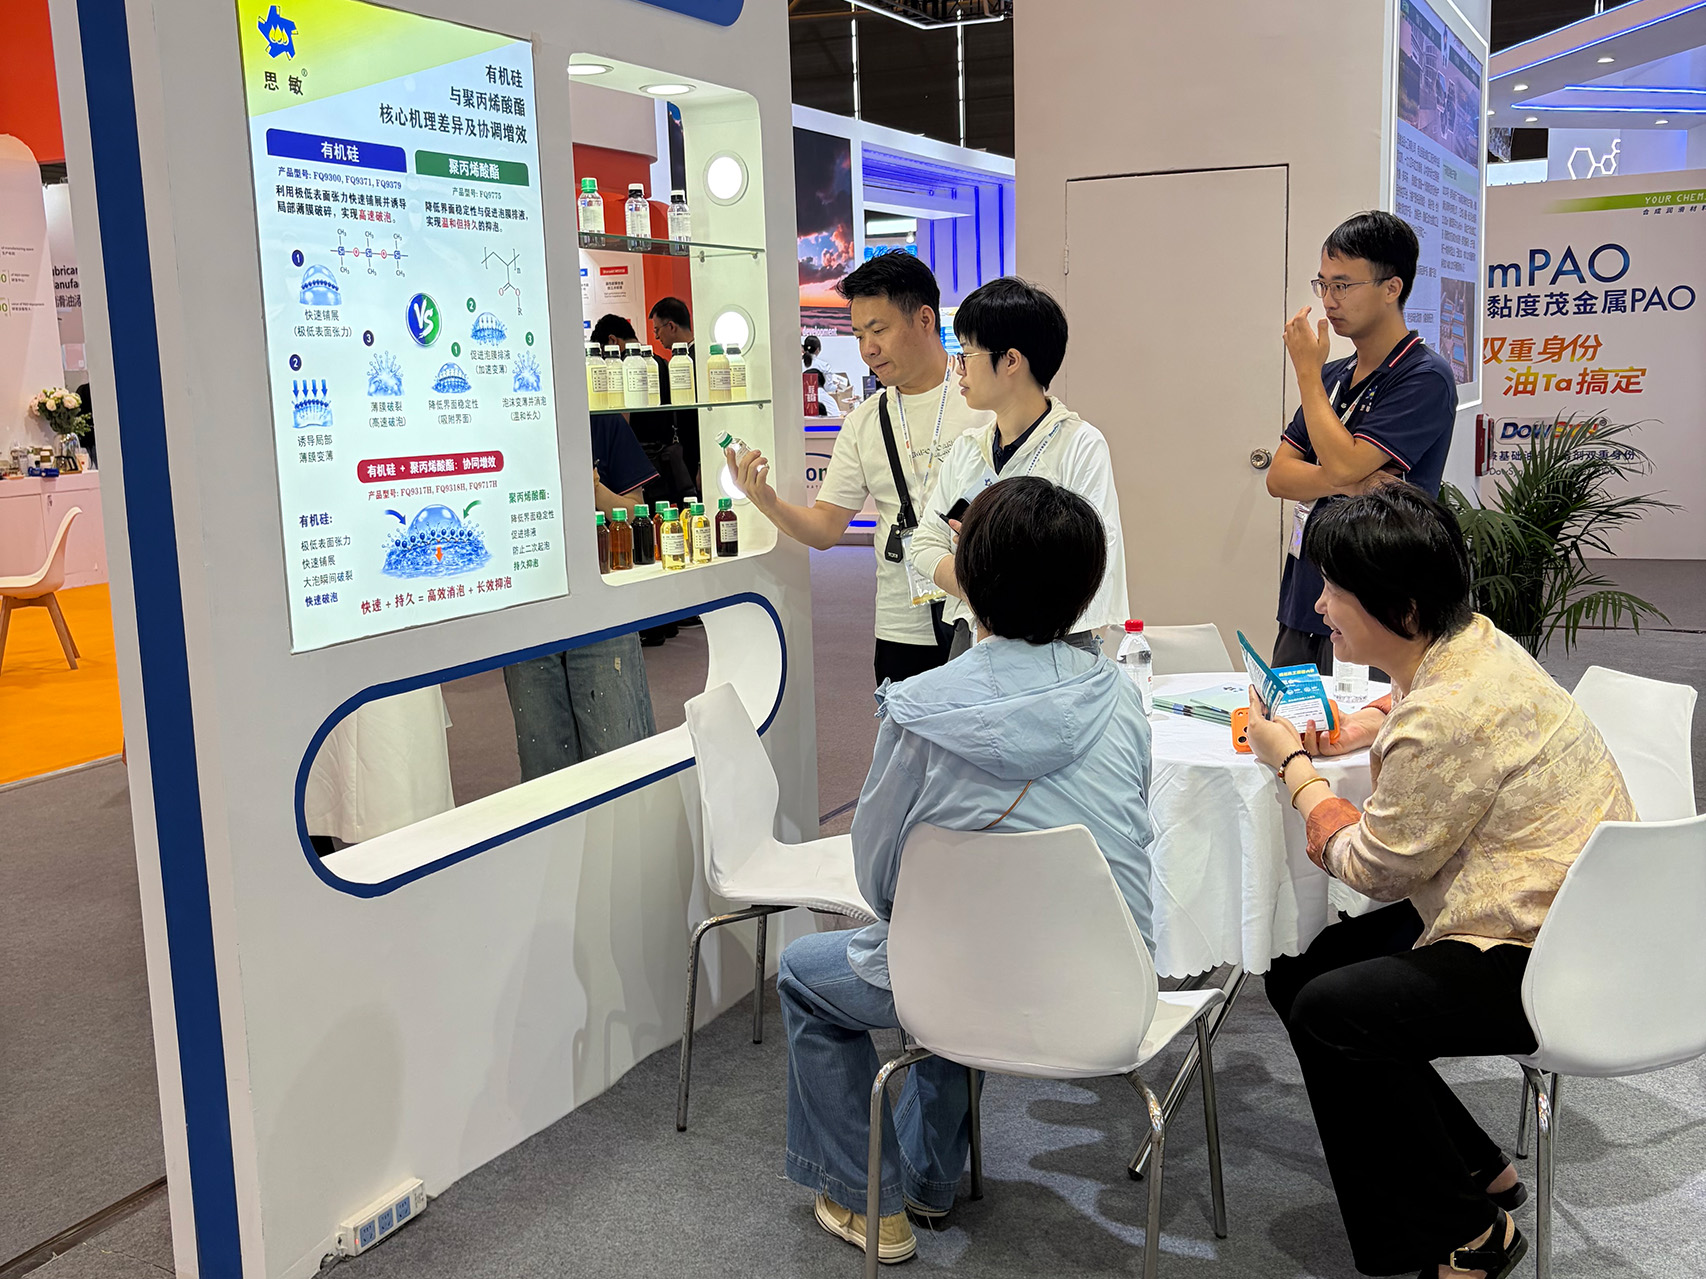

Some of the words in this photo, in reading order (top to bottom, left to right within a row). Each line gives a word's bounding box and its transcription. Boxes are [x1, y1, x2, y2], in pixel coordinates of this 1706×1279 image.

[485, 64, 523, 88] 有机硅
[449, 86, 525, 117] 与聚丙烯酸酯
[379, 102, 527, 144] 核心机理差异及协调增效
[321, 141, 360, 162] 有机硅
[448, 158, 500, 180] 聚丙烯酸酯
[276, 185, 407, 210] 利用极低表面张力快速铺展并诱导
[1645, 195, 1671, 204] YOUR
[1677, 192, 1706, 203] CHEM
[1488, 243, 1630, 288] mPAO
[1487, 285, 1696, 319] 黏度茂金属PAO
[304, 309, 339, 321] 快速铺展
[413, 297, 434, 339] VS
[293, 326, 352, 337] (极低表面张力)
[1483, 334, 1603, 365] 双重身份
[475, 364, 507, 375] (加速变薄)
[1502, 366, 1647, 397] 油Ta搞定
[371, 401, 403, 412] 薄膜破裂
[428, 399, 479, 411] 降低界面稳定性
[369, 416, 406, 428] (高速破泡)
[297, 434, 333, 447] 诱导局部
[298, 450, 334, 463] 薄膜变薄
[367, 462, 397, 478] 有机硅
[510, 510, 554, 524] 降低界面稳定性
[300, 535, 351, 552] 极低表面张力
[512, 541, 551, 556] 防止二次起泡
[302, 555, 335, 570] 快速铺展
[513, 558, 539, 571] 持久抑泡
[303, 570, 353, 588] 大泡瞬间破裂
[305, 592, 338, 607] 快速破泡
[361, 598, 382, 614] 快速
[395, 593, 415, 608] 持久
[427, 584, 465, 602] 高效消泡
[476, 575, 513, 594] 长效抑泡
